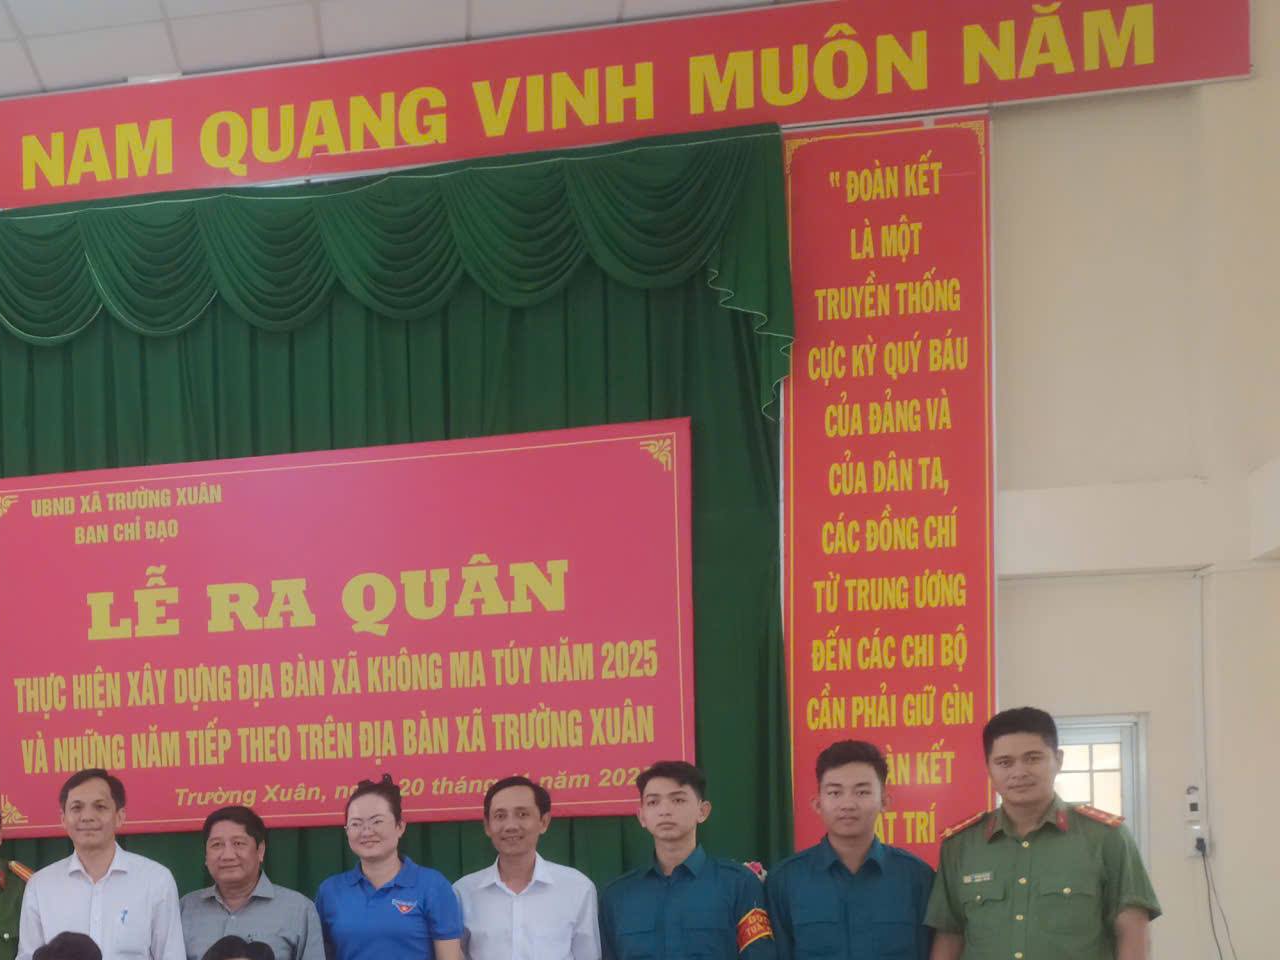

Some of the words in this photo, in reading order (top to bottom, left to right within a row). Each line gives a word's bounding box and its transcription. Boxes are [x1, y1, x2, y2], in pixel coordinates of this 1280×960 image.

[22, 118, 173, 190] NAM
[200, 86, 447, 177] QUANG
[472, 62, 654, 138] VINH
[689, 23, 928, 115] MUÔN
[963, 2, 1156, 85] NĂM
[847, 160, 899, 203] ĐOÀN
[905, 150, 943, 196] KẾT
[850, 218, 875, 260] LÀ
[881, 215, 923, 263] MỘT
[815, 272, 890, 321] TRUYỀN
[896, 267, 961, 312] THỐNG
[808, 341, 846, 386] CỰC
[852, 336, 877, 377] KỲ
[884, 331, 923, 380] QUÝ
[929, 329, 969, 372] BÁU
[825, 392, 863, 437] CỦA
[869, 388, 921, 434] ĐẢNG
[926, 389, 952, 430] VÀ
[829, 450, 867, 496] CỦA
[873, 450, 913, 493] DÂN
[919, 457, 949, 496] TA,
[31, 497, 75, 518] UBND
[80, 490, 103, 514] XÃ
[107, 485, 171, 511] TRƯỜNG
[176, 481, 222, 506] XUÂN
[74, 524, 109, 545] BAN
[145, 519, 178, 543] ĐẠO
[822, 512, 861, 554] CÁC
[866, 504, 919, 551] ĐỒNG
[924, 506, 958, 548] CHÍ
[86, 564, 180, 641] LỄ
[207, 578, 316, 633] RA
[341, 553, 569, 637] QUÂN
[813, 571, 841, 613] TỪ
[845, 576, 910, 611] TRUNG
[915, 569, 967, 608] ƯƠNG
[811, 626, 851, 672] ĐẾN
[857, 628, 896, 670] CÁC
[901, 634, 935, 668] CHI
[941, 624, 968, 672] BỘ
[14, 673, 67, 719] THỰC
[72, 666, 121, 717] HIỆN
[127, 663, 167, 706] XÂY
[174, 663, 232, 710] DỰNG
[237, 663, 274, 707] ĐỊA
[280, 653, 325, 699] BÀN
[332, 650, 362, 695] XÃ
[367, 647, 443, 692] KHÔNG
[449, 651, 486, 688] MA
[491, 640, 534, 686] TÚY
[540, 637, 594, 683] NĂM
[601, 639, 658, 680] 2025
[807, 683, 846, 730] CẦN
[851, 682, 897, 728] PHẢI
[903, 684, 936, 727] GIỮ
[942, 683, 974, 725] GÌN
[54, 728, 125, 772] NHỮNG
[131, 725, 180, 769] NĂM
[186, 717, 231, 765] TIẾP
[238, 725, 290, 763] THEO
[297, 715, 353, 760] TRÊN
[359, 719, 397, 765] ĐỊA
[403, 710, 449, 756] BÀN
[456, 708, 486, 753] XÃ
[491, 702, 583, 751] TRƯỜNG
[590, 698, 654, 746] XUÂN
[884, 744, 910, 784] ÀN
[917, 739, 955, 785] KẾT
[175, 787, 257, 808] Trường
[399, 777, 424, 797] 20
[540, 773, 590, 790] năm
[599, 766, 652, 787] 202
[903, 802, 937, 844] TRÍ
